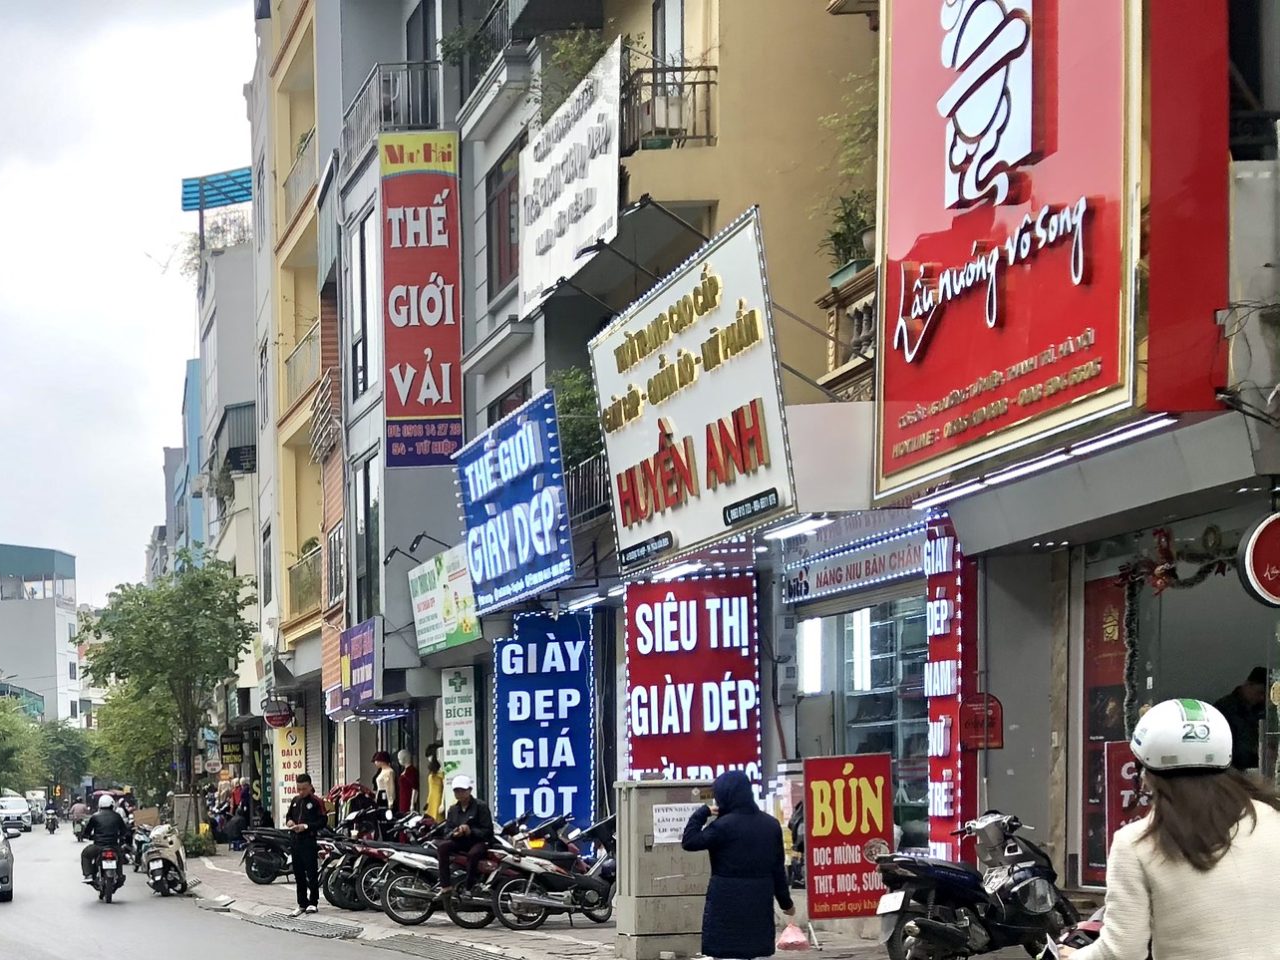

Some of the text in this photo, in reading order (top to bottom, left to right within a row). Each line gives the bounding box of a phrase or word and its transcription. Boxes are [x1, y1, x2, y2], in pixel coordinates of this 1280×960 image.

[387, 188, 450, 249] THẾ
[388, 272, 455, 328] GIỚI
[669, 294, 694, 334] CAO
[389, 347, 453, 407] VẢI
[465, 415, 538, 502] THẾ GIỚI
[616, 397, 770, 528] HUYỀN ANH
[468, 503, 512, 585] GIÀY
[513, 473, 559, 565] DÉP
[924, 526, 951, 576] GIÀY
[865, 554, 886, 575] BÀN
[889, 543, 920, 571] CHÂN
[635, 592, 749, 656] SIÊU THỊ
[927, 587, 950, 636] DÉP
[501, 633, 585, 675] GIÀY
[630, 671, 757, 736] GIÀY DÉP
[924, 661, 953, 698] NAM
[445, 706, 472, 719] BÍCH
[507, 688, 581, 727] ĐẸP
[512, 727, 576, 769] GIÁ
[510, 771, 578, 820] TỐT
[810, 762, 884, 837] BÚN
